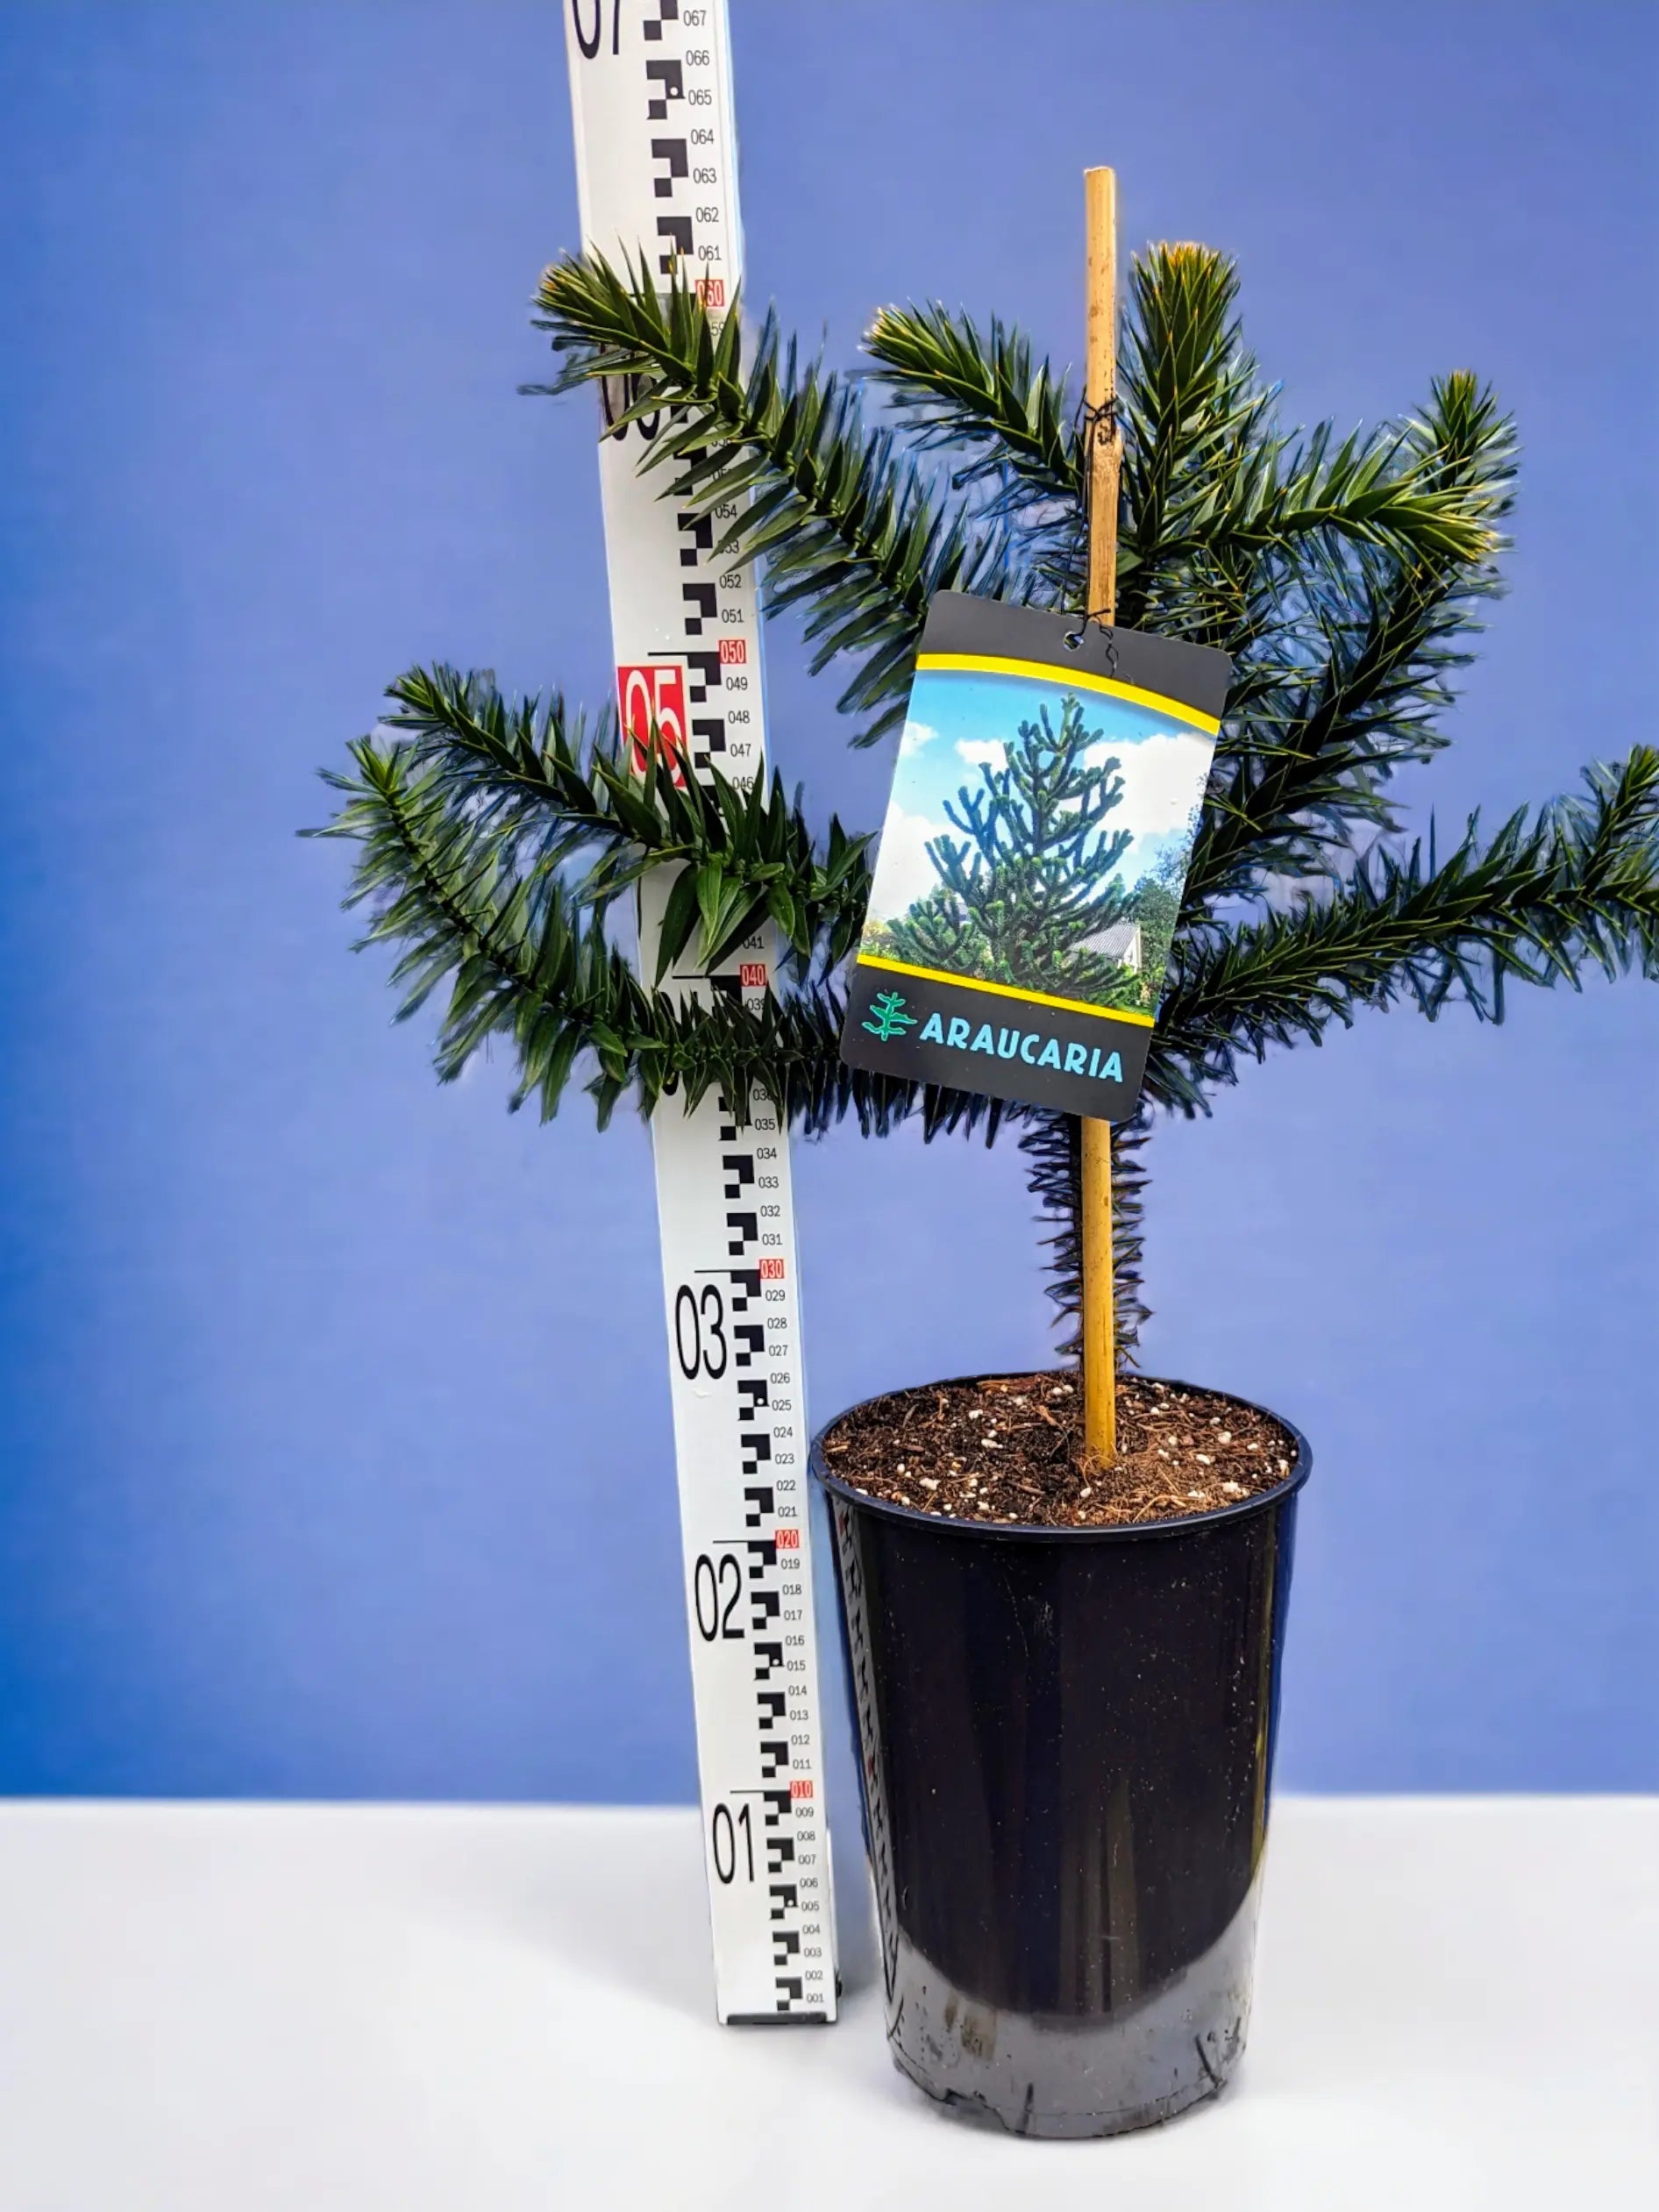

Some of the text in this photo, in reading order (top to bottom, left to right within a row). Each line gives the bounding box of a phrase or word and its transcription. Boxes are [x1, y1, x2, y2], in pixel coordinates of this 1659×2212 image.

[684, 10, 706, 25] 067
[686, 50, 709, 66] 066
[688, 89, 712, 105] 065
[691, 129, 714, 145] 064
[694, 168, 716, 183] 063
[696, 207, 719, 223] 062
[698, 246, 722, 260] 061
[715, 504, 737, 518] 054
[720, 574, 741, 589] 052
[722, 609, 744, 623] 051
[721, 640, 744, 662] 050
[726, 677, 747, 690] 049
[729, 710, 750, 724] 048
[625, 669, 682, 784] 05
[730, 744, 751, 757] 047
[732, 776, 754, 789] 046
[744, 936, 764, 949] 041
[742, 965, 764, 985] 040
[920, 1012, 1123, 1084] ARAUCARIA
[755, 1118, 775, 1130] 035
[757, 1148, 777, 1159] 034
[758, 1176, 779, 1188] 033
[760, 1205, 780, 1217] 032
[762, 1234, 782, 1245] 031
[761, 1261, 783, 1279] 030
[765, 1289, 785, 1301] 029
[767, 1317, 787, 1329] 028
[675, 1284, 727, 1380] 03
[769, 1345, 787, 1356] 027
[771, 1373, 790, 1384] 026
[772, 1400, 791, 1410] 025
[773, 1427, 793, 1438] 024
[775, 1453, 794, 1465] 023
[777, 1480, 795, 1491] 022
[778, 1506, 797, 1517] 021
[777, 1531, 798, 1548] 020
[781, 1559, 800, 1569] 019
[782, 1584, 801, 1595] 018
[694, 1554, 744, 1641] 02
[784, 1609, 802, 1621] 017
[786, 1635, 804, 1645] 016
[787, 1660, 806, 1671] 015
[788, 1686, 807, 1695] 014
[790, 1709, 808, 1721] 013
[791, 1734, 809, 1745] 012
[793, 1759, 811, 1769] 011
[792, 1781, 812, 1797] 010
[796, 1807, 814, 1817] 009
[797, 1831, 815, 1841] 008
[713, 1803, 754, 1884] 01
[798, 1854, 815, 1865] 007
[800, 1878, 818, 1887] 006
[801, 1901, 819, 1911] 005
[802, 1924, 820, 1934] 004
[804, 1947, 822, 1958] 003
[805, 1971, 822, 1980] 002
[807, 1994, 823, 2003] 001
